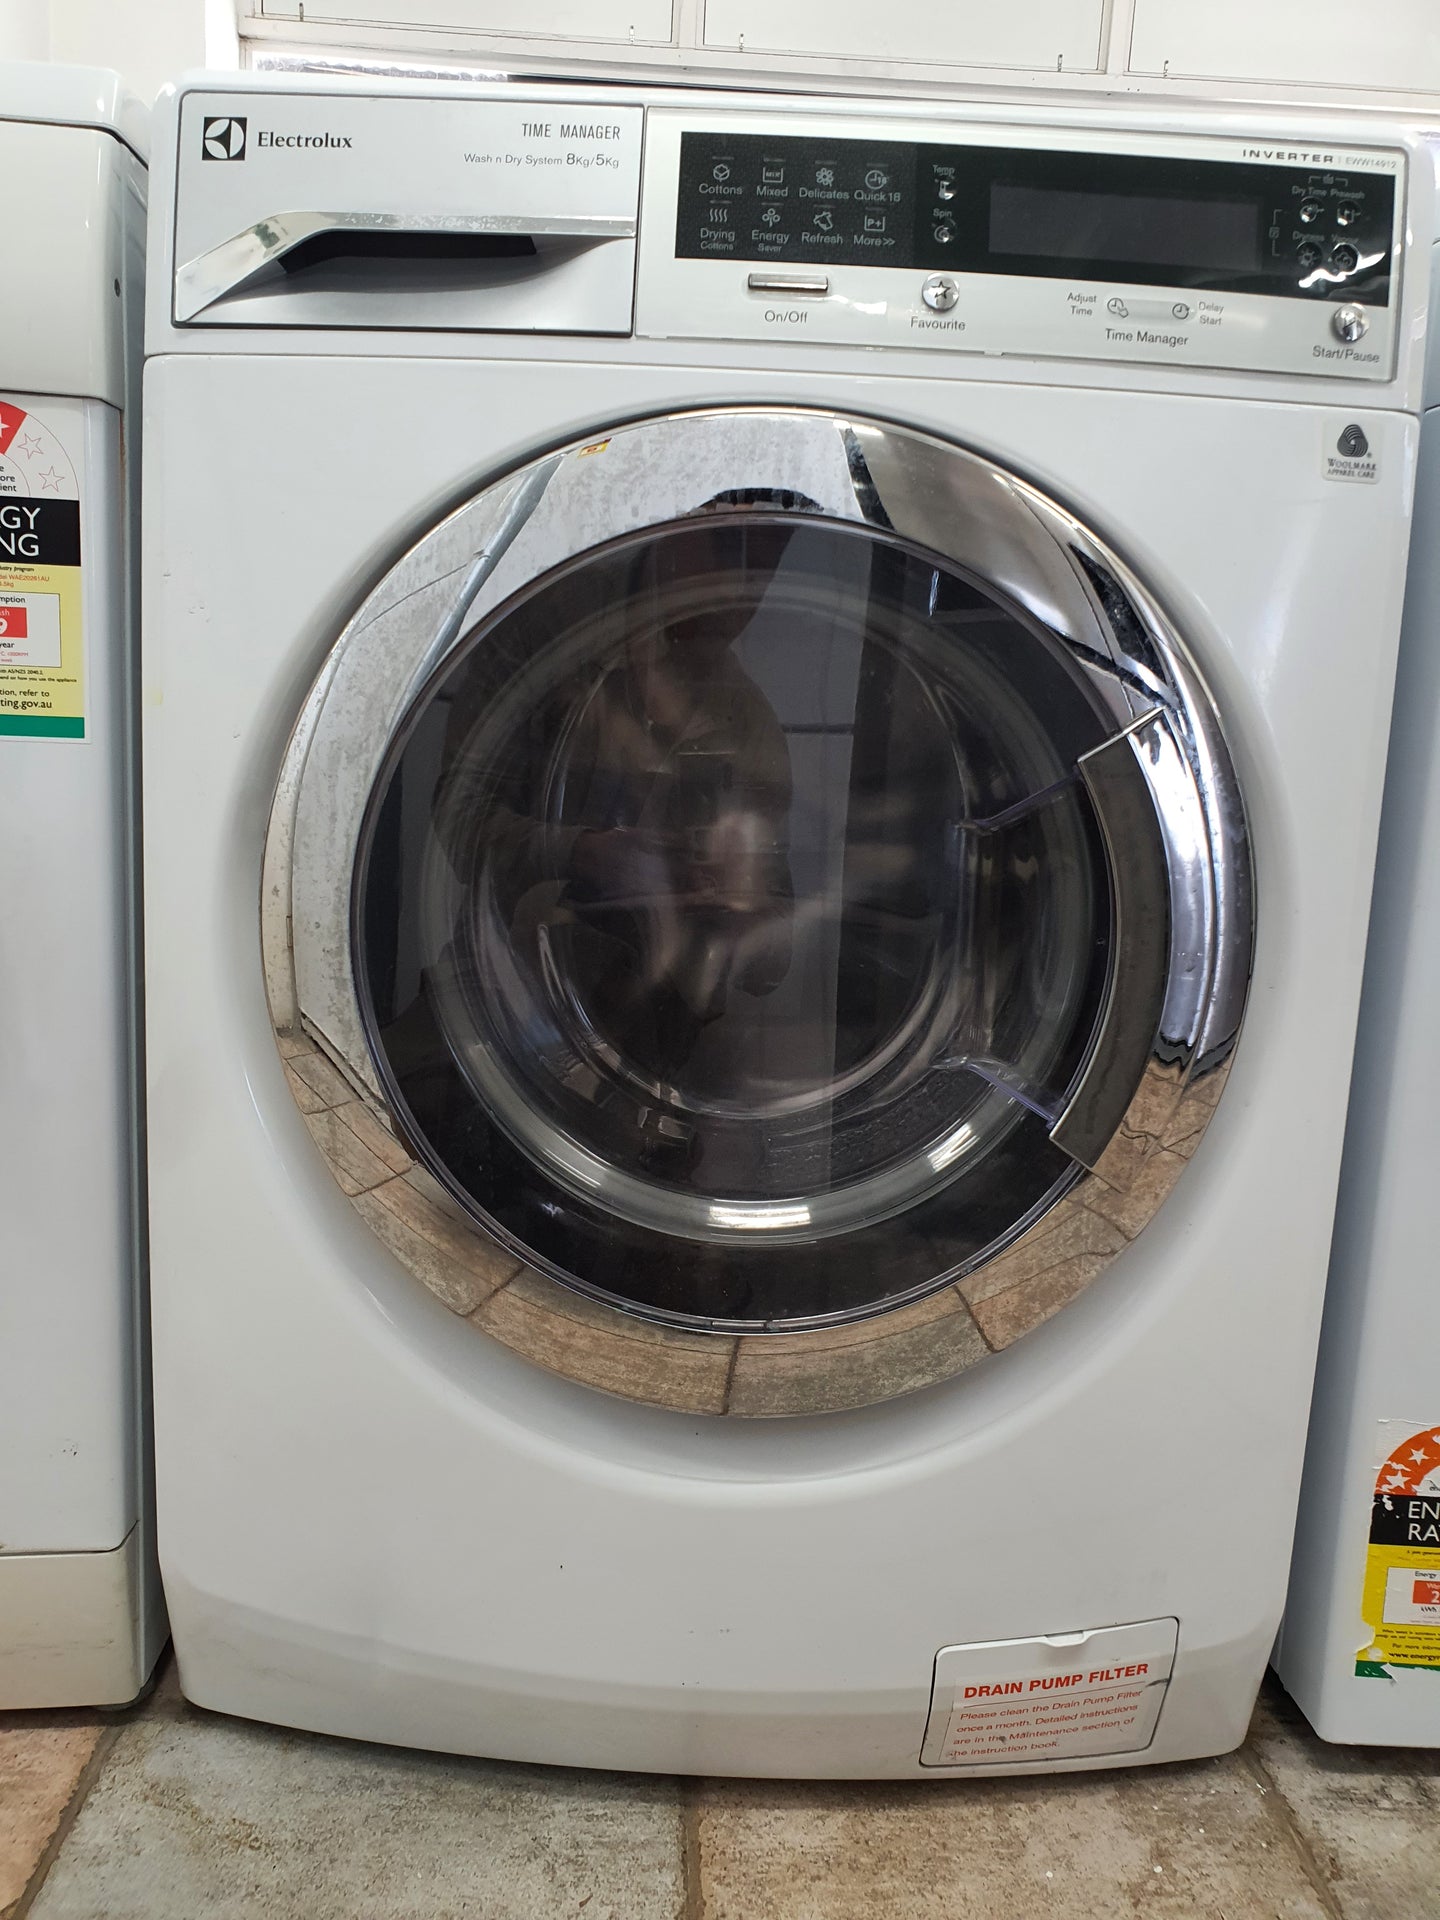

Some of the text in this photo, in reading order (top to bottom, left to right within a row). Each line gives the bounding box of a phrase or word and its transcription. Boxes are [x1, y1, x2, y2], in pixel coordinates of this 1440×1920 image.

[522, 124, 621, 140] TIME MANAGER
[256, 131, 353, 150] Electrolux
[464, 153, 493, 165] Wash
[495, 157, 502, 165] n
[505, 154, 523, 168] Dry
[525, 154, 564, 168] System
[1243, 149, 1334, 164] INVERTER
[699, 184, 743, 196] Cottons
[756, 186, 788, 198] Mixed
[799, 187, 850, 200] Delicates
[854, 190, 886, 202] Quick
[932, 208, 953, 220] Spin
[700, 228, 736, 242] Drying
[752, 230, 790, 244] Energy
[802, 232, 844, 245] Refresh
[1067, 292, 1097, 305] Adjust
[1070, 306, 1093, 316] Time
[1198, 301, 1225, 314] Delay
[764, 310, 808, 324] On/Off
[910, 316, 966, 332] Favourite
[1200, 315, 1222, 326] Start
[1105, 328, 1189, 348] Time Manager
[1312, 345, 1380, 364] Start/Pause
[1328, 458, 1376, 470] WOOLMARK
[19, 689, 38, 697] refer
[41, 690, 50, 698] to
[1408, 1523, 1440, 1542] RA
[964, 1662, 1150, 1700] DRAIN PUMP FILTER
[960, 1689, 1144, 1721] Please clean the Drain Pump Filter
[956, 1724, 984, 1734] once
[986, 1724, 994, 1732] a
[1035, 1712, 1078, 1726] Detailed
[1079, 1704, 1138, 1721] instructions
[952, 1738, 972, 1746] are
[974, 1736, 985, 1744] in
[1009, 1727, 1079, 1741] Maintenance
[1082, 1720, 1121, 1733] section
[1122, 1717, 1136, 1727] of
[970, 1744, 1028, 1756] instruction
[1030, 1740, 1061, 1750] book.
